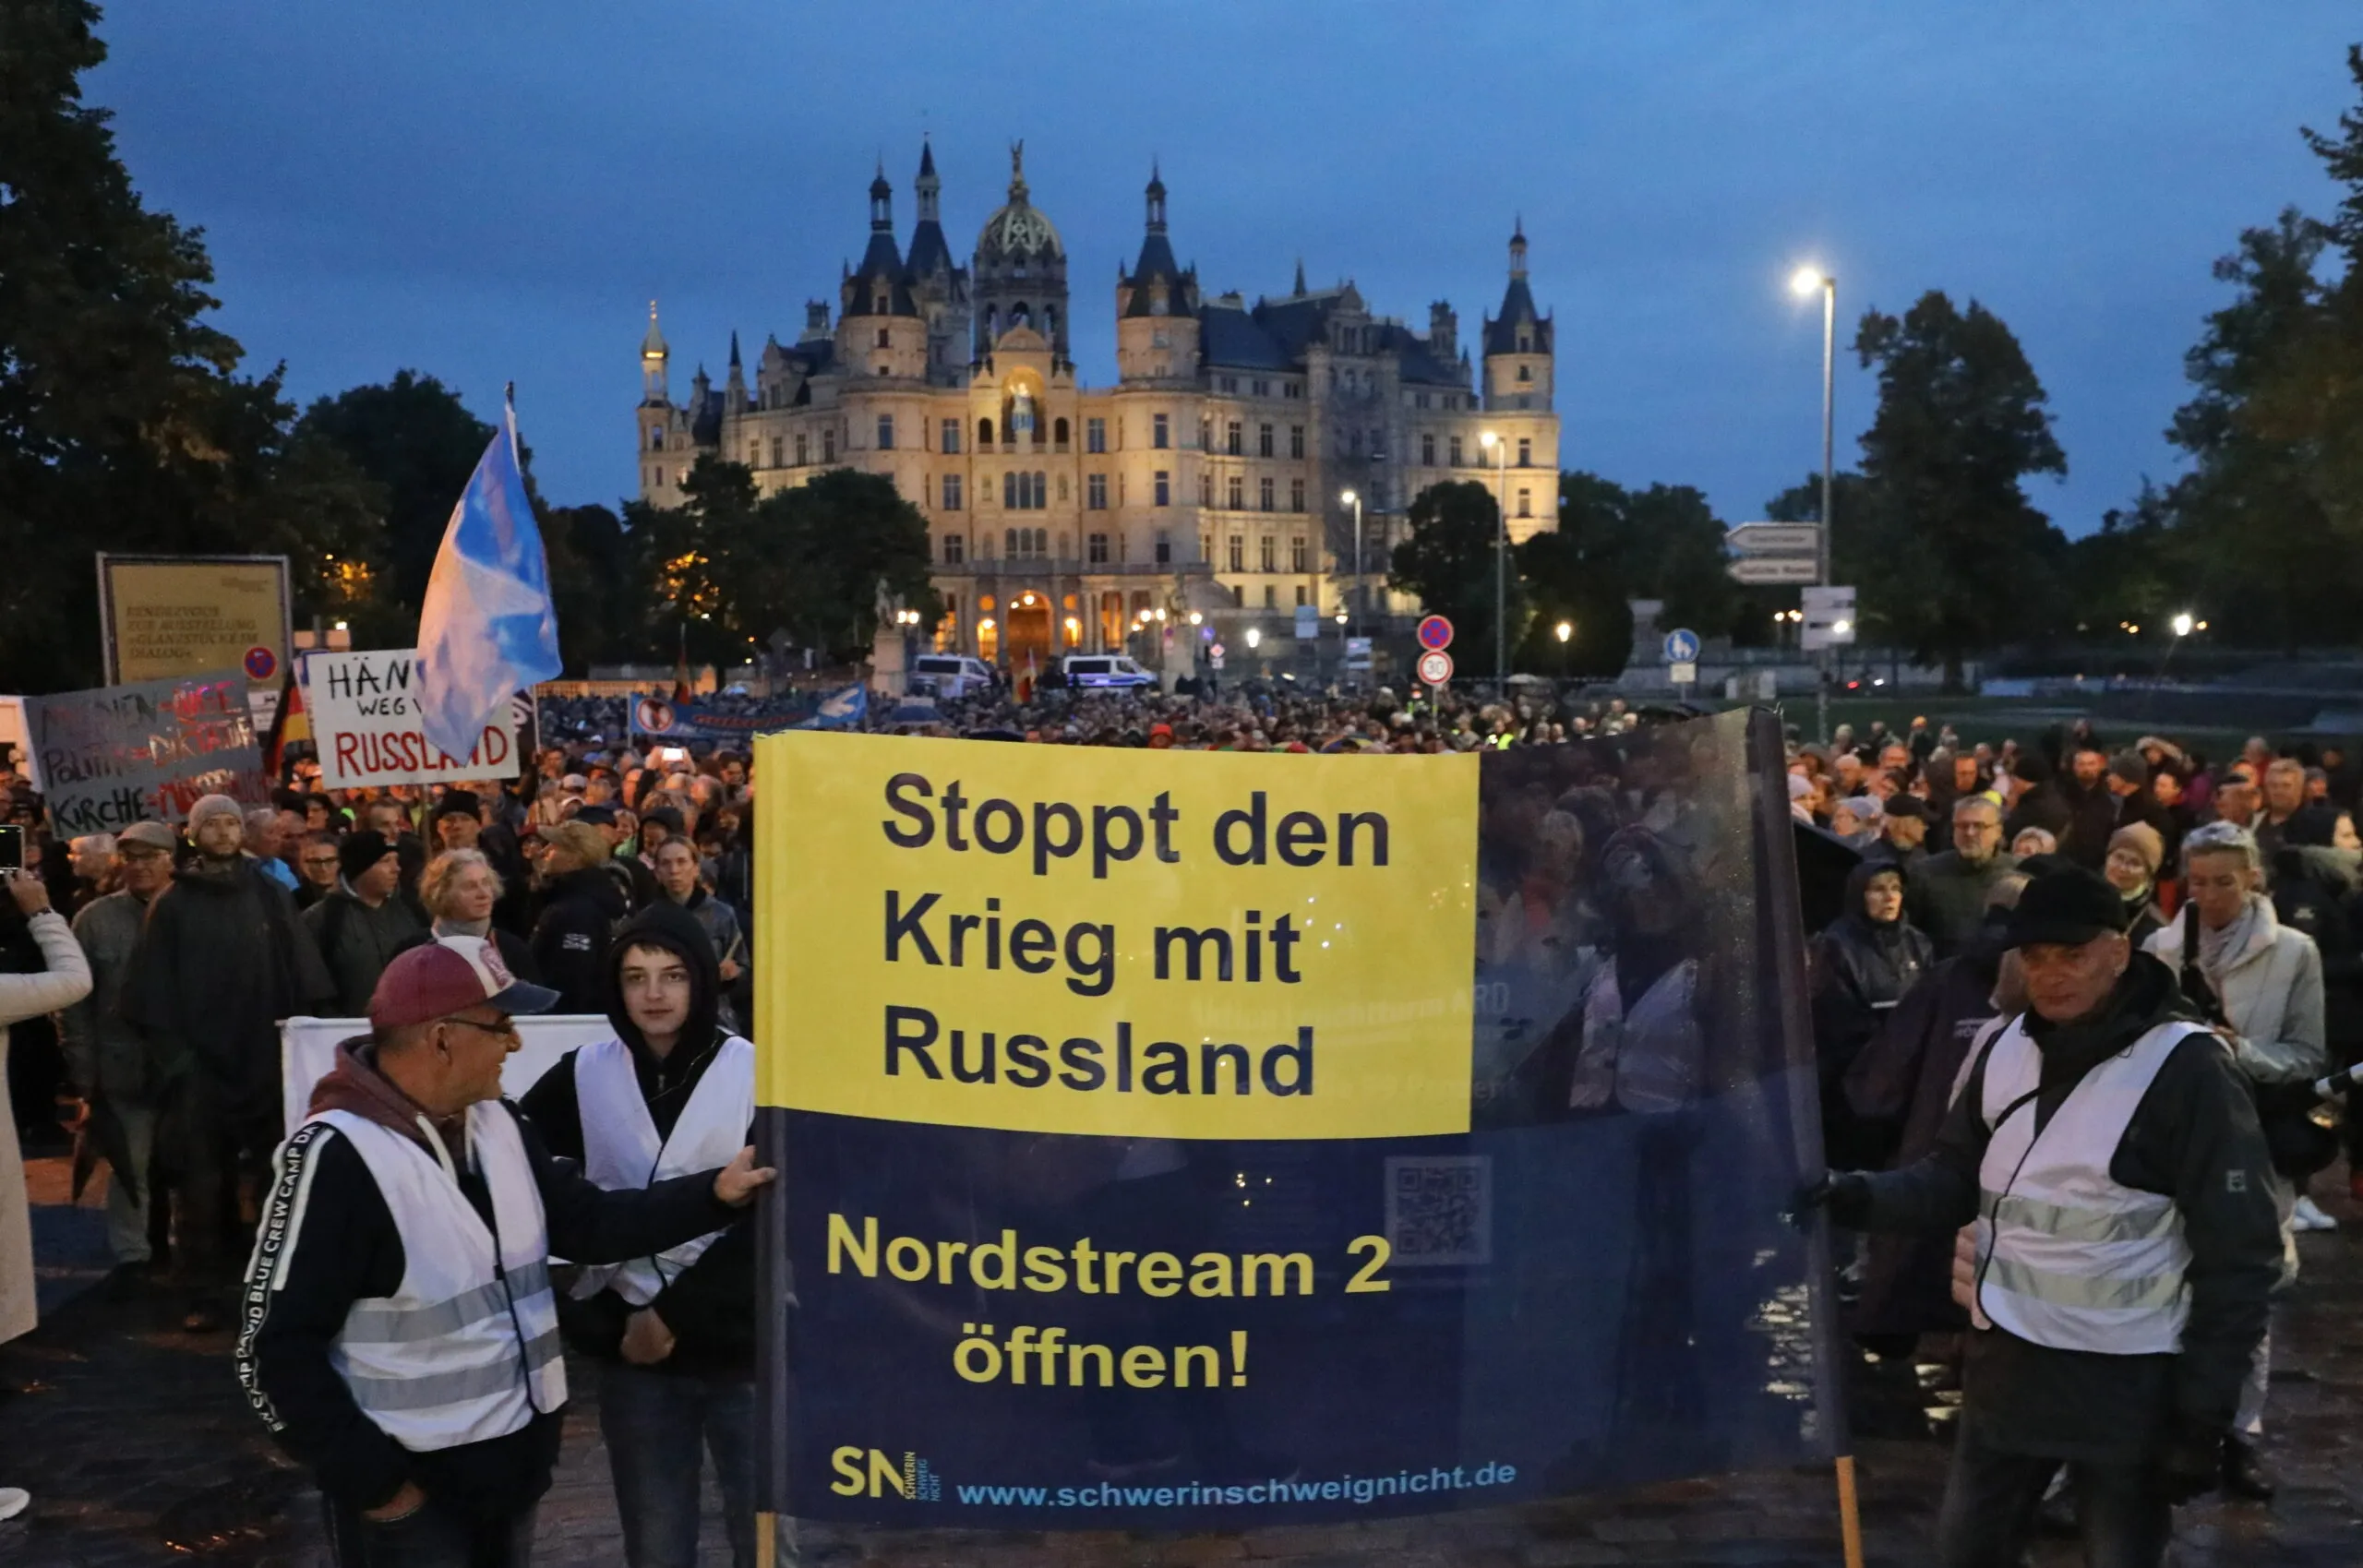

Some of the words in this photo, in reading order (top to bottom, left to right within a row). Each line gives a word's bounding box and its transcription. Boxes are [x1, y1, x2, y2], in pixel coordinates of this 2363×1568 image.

[328, 655, 411, 700] HÄN
[1426, 659, 1444, 676] 30
[356, 698, 406, 716] WEG
[335, 725, 509, 778] RUSSLD
[882, 773, 1180, 880] Stoppt
[1213, 792, 1388, 868] den
[885, 891, 1115, 997] Krieg
[1154, 911, 1301, 984] mit
[885, 1005, 1313, 1097] Russland
[249, 1256, 274, 1303] BLUE
[264, 1200, 288, 1252] CREW
[279, 1147, 303, 1198] CAMP
[828, 1214, 1313, 1298] Nordstream
[1346, 1235, 1391, 1293] 2
[954, 1323, 1247, 1388] öffnen!
[832, 1446, 904, 1498] SN
[904, 1451, 917, 1500] SCHWERIN
[956, 1461, 1517, 1509] www.schwerinschweignicht.de
